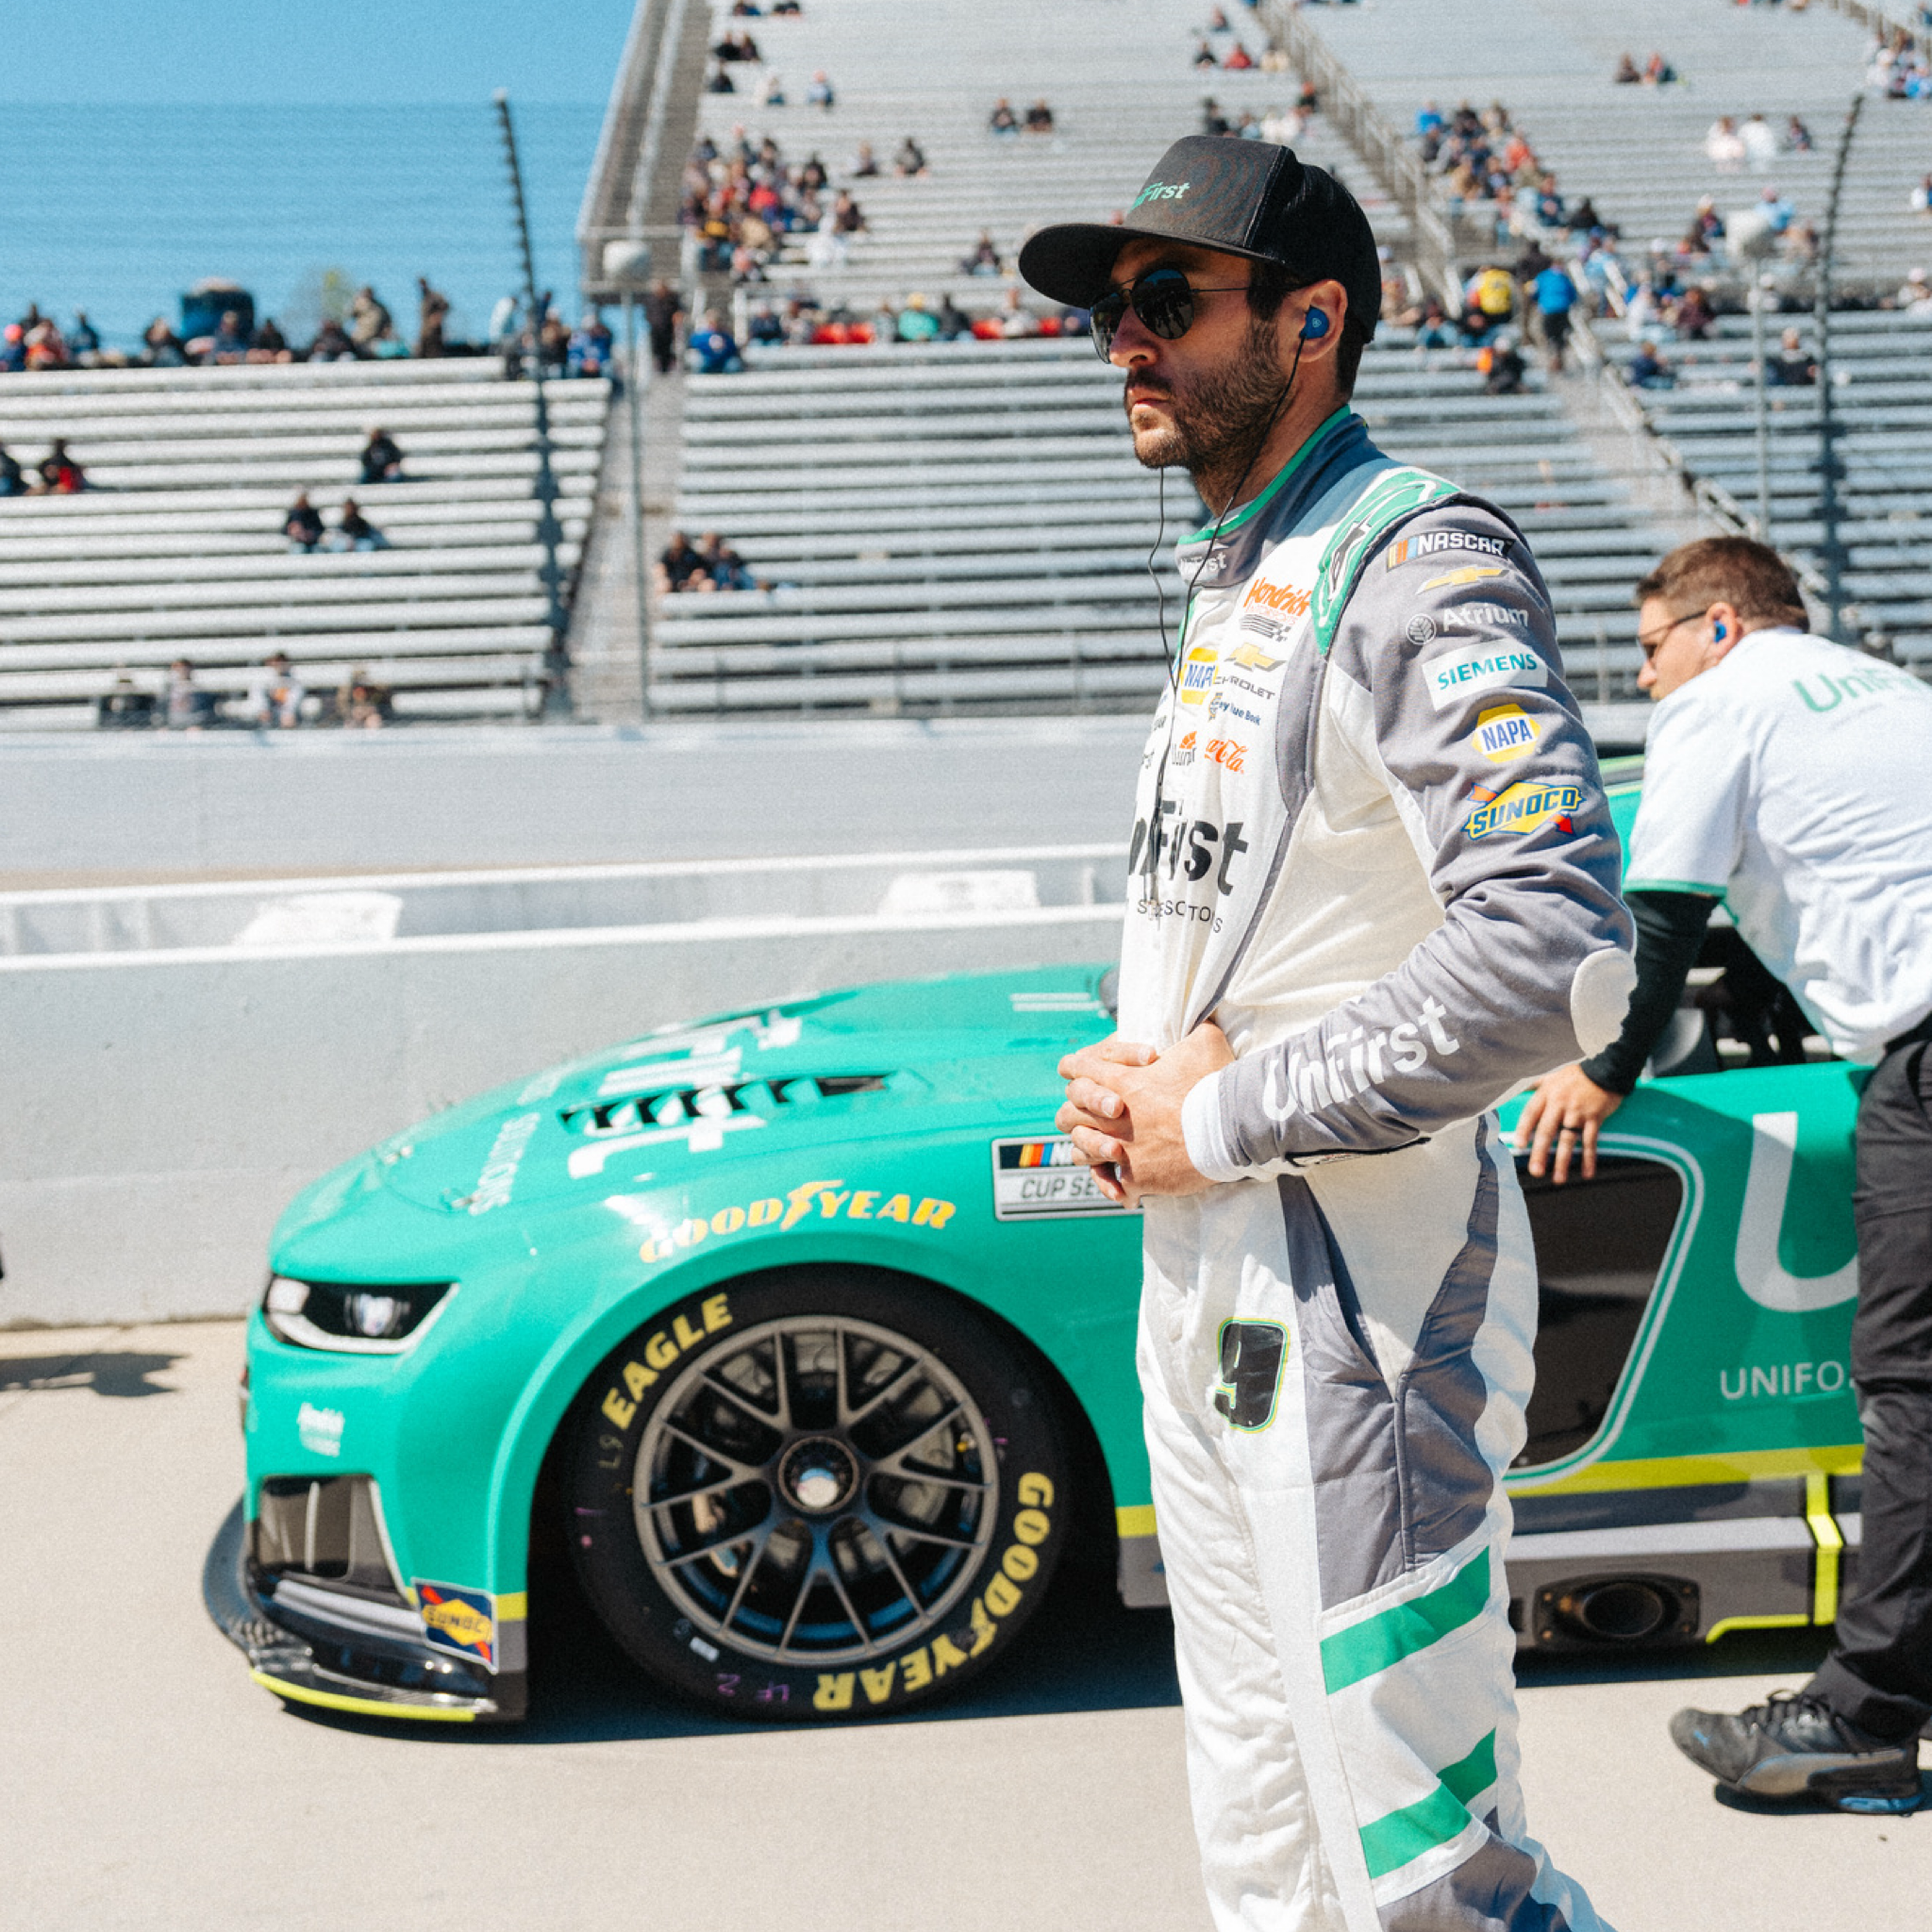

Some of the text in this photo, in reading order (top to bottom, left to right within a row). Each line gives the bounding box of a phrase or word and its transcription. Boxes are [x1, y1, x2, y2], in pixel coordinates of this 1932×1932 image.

[1417, 532, 1506, 557] NASCAR
[1442, 603, 1528, 632] Atrium
[1437, 653, 1539, 691] SIEMENS
[1481, 719, 1533, 752] NAPA
[1474, 788, 1577, 835] SUNOCO
[1021, 1176, 1102, 1199] CUP SE
[639, 1179, 957, 1263] GOODYEAR
[601, 1292, 733, 1430] EAGLE
[1215, 1318, 1290, 1433] 9
[1720, 1360, 1857, 1401] UNIFO
[812, 1472, 1055, 1710] GOODYEAR
